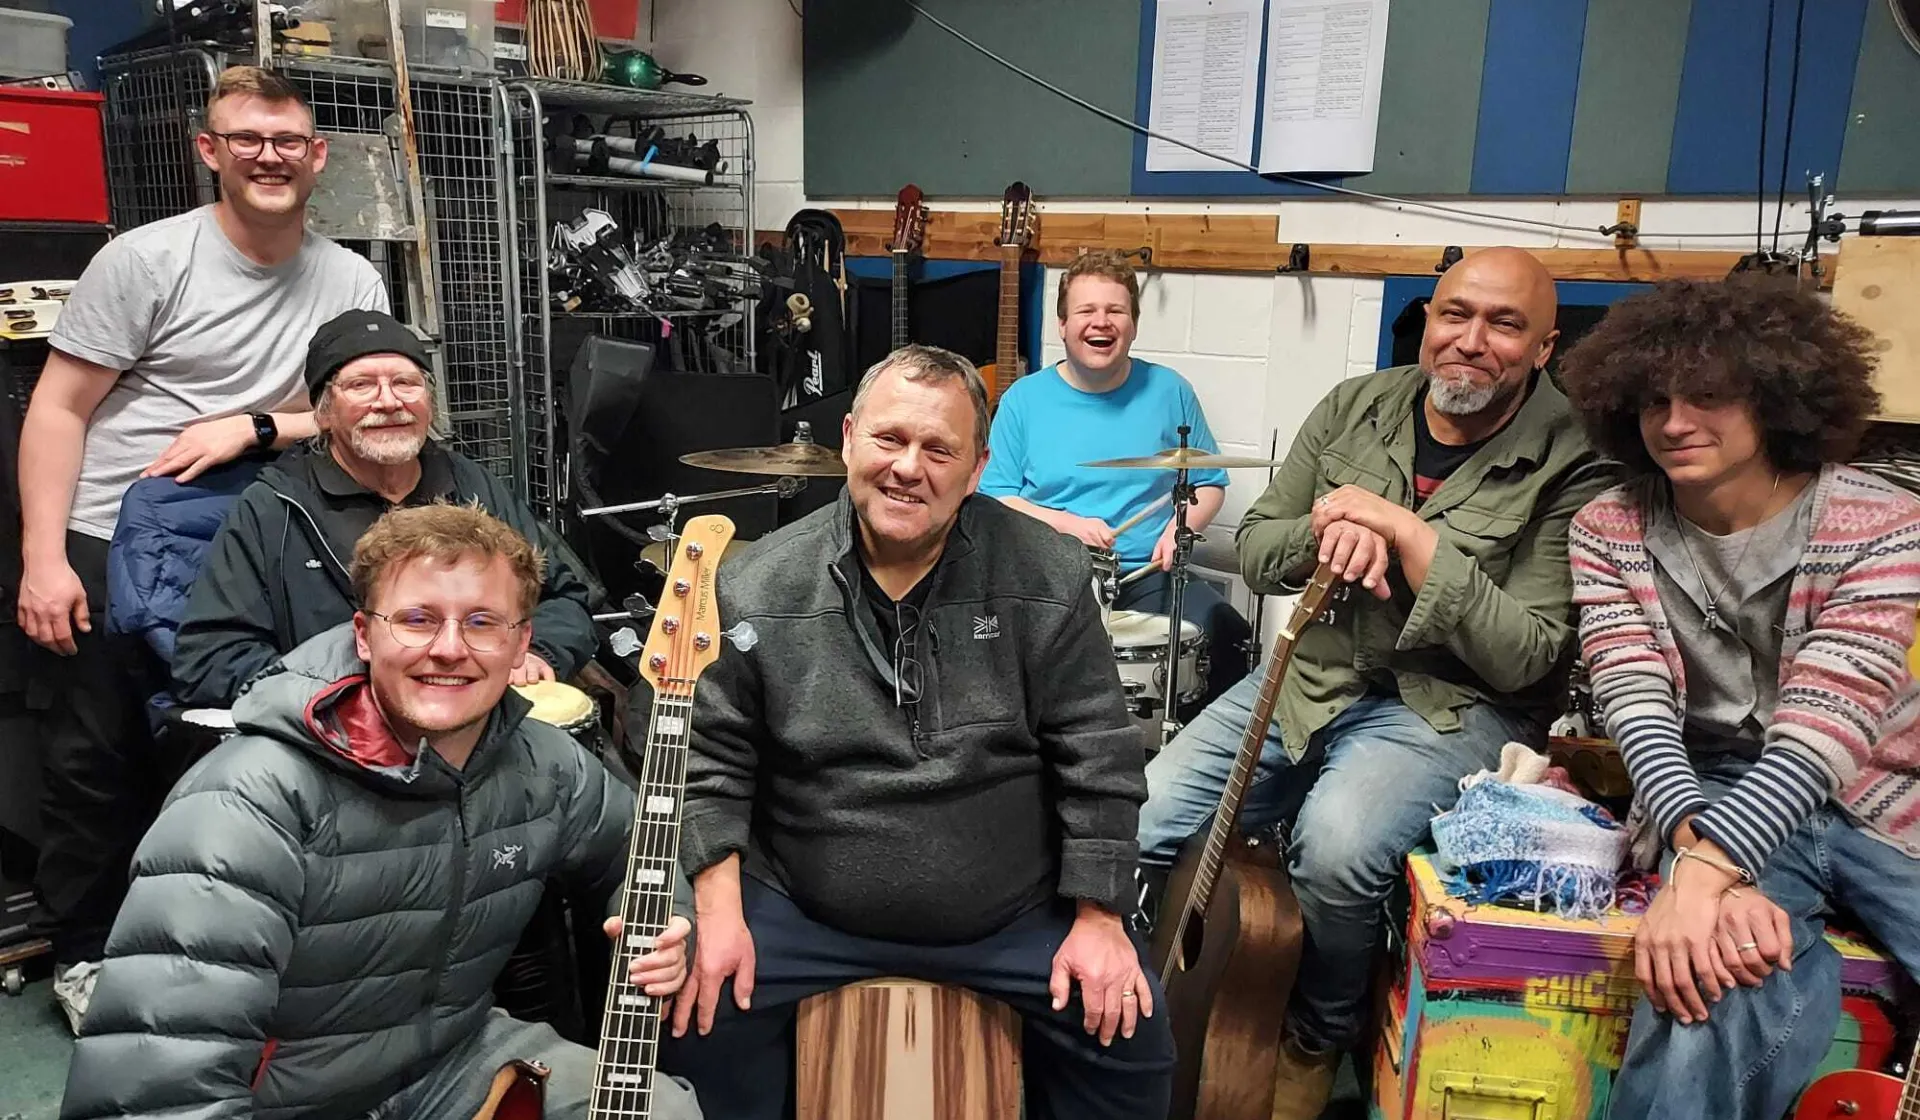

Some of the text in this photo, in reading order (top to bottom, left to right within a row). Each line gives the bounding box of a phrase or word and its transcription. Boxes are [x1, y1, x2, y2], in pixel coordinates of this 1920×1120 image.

[803, 350, 822, 397] Pearl
[700, 567, 712, 590] Miller
[696, 591, 709, 621] Marcus
